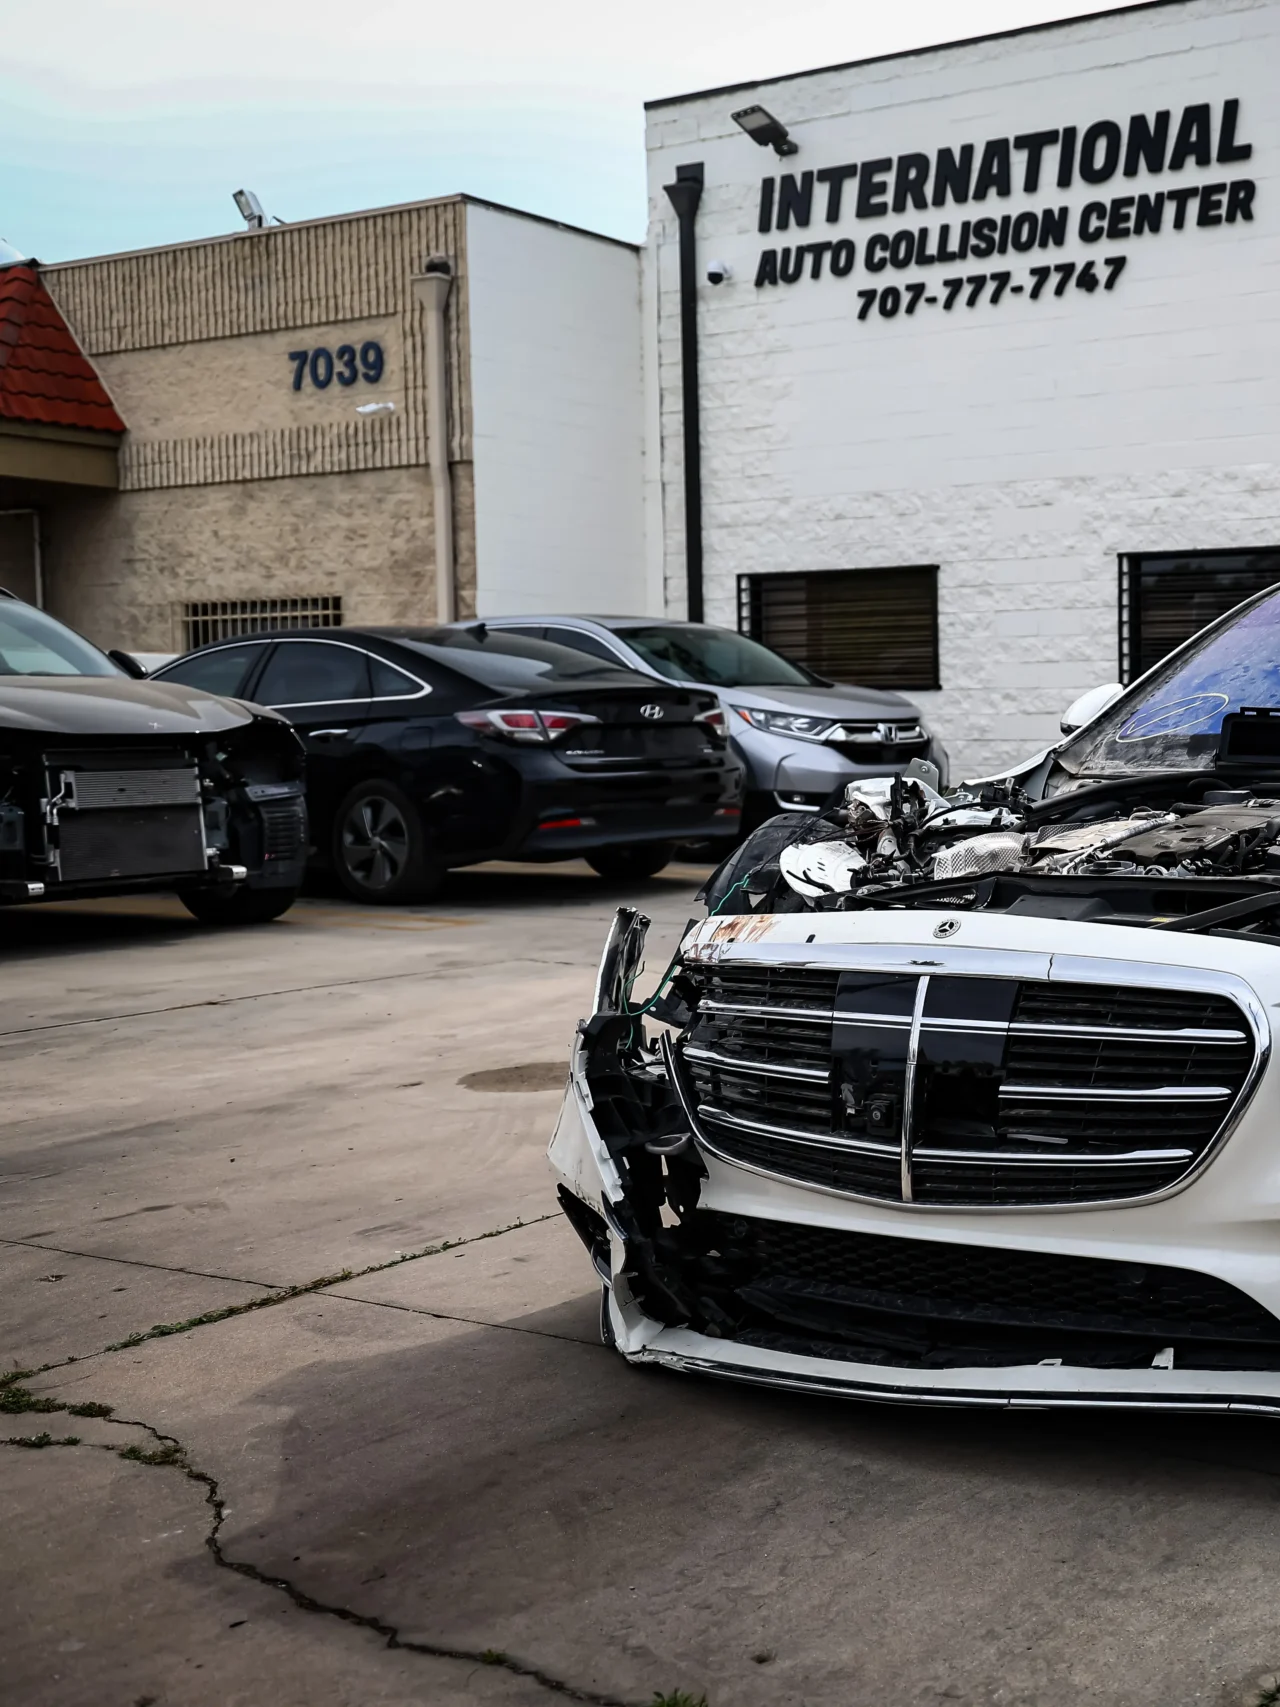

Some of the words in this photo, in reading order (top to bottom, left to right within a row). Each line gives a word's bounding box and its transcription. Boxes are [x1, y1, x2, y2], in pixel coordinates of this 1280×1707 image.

[757, 97, 1253, 233] INTERNATIONAL
[755, 240, 854, 288] AUTO
[864, 206, 1068, 272] COLLISION
[1078, 179, 1256, 243] CENTER
[856, 255, 1127, 321] 707-777-7747
[288, 341, 384, 391] 7039
